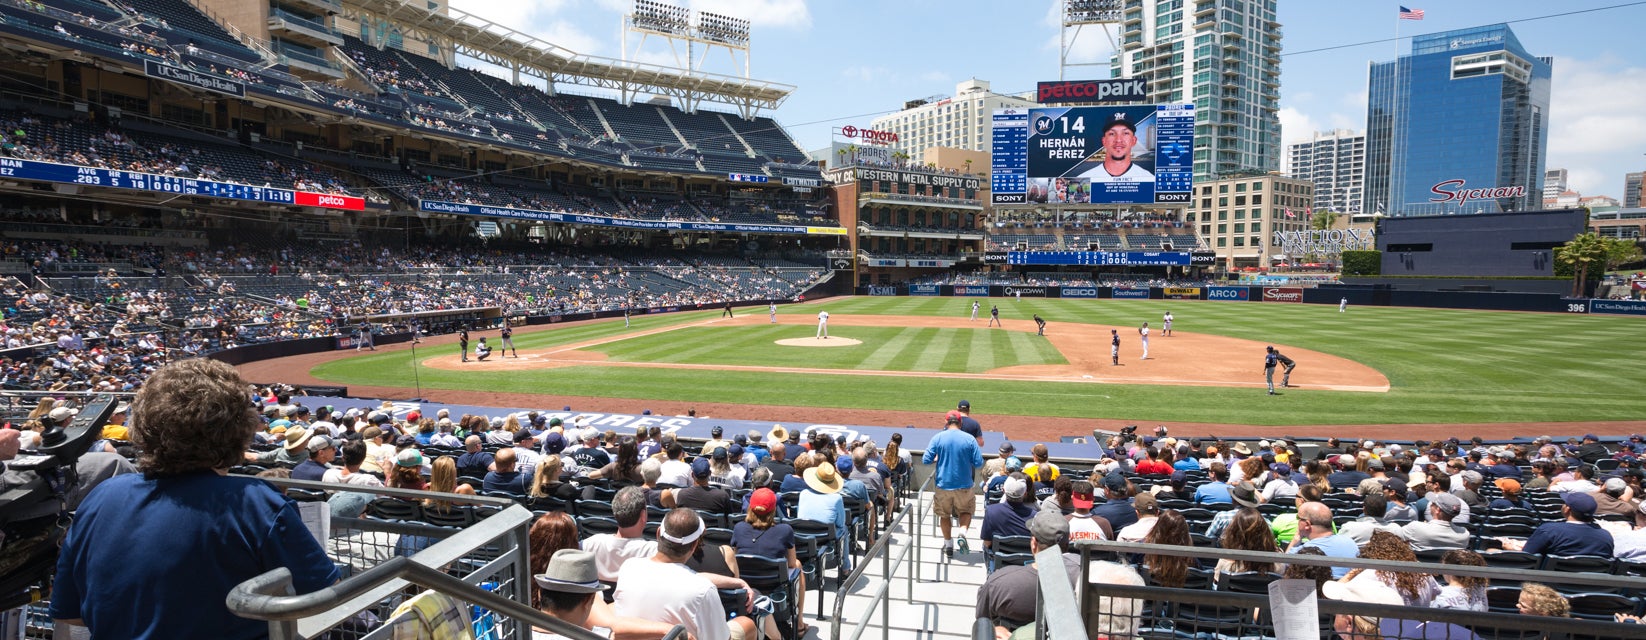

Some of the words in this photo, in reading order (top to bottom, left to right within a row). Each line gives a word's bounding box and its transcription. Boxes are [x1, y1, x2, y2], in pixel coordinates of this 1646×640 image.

[189, 73, 212, 87] Diego
[212, 79, 237, 92] Health
[1060, 116, 1085, 134] 14
[860, 128, 899, 143] TOYOTA
[1040, 136, 1085, 148] HERNÁN
[858, 146, 887, 162] PADRES
[1049, 146, 1085, 159] PÉREZ
[78, 167, 97, 176] AVG
[128, 172, 144, 180] RBI
[856, 168, 899, 181] WESTERN
[902, 173, 930, 185] METAL
[932, 176, 963, 188] SUPPLY
[966, 179, 979, 189] CO.
[74, 175, 100, 185] .283
[112, 178, 119, 187] 5
[132, 180, 145, 189] 18
[186, 179, 199, 187] MIL
[268, 190, 291, 201] 1:19
[1429, 179, 1528, 207] Sycuan
[318, 196, 344, 206] petco
[869, 287, 895, 296] ASML
[1267, 289, 1298, 300] Sycuan
[1568, 304, 1584, 312] 396
[575, 454, 594, 462] SALTY
[639, 448, 649, 459] 4
